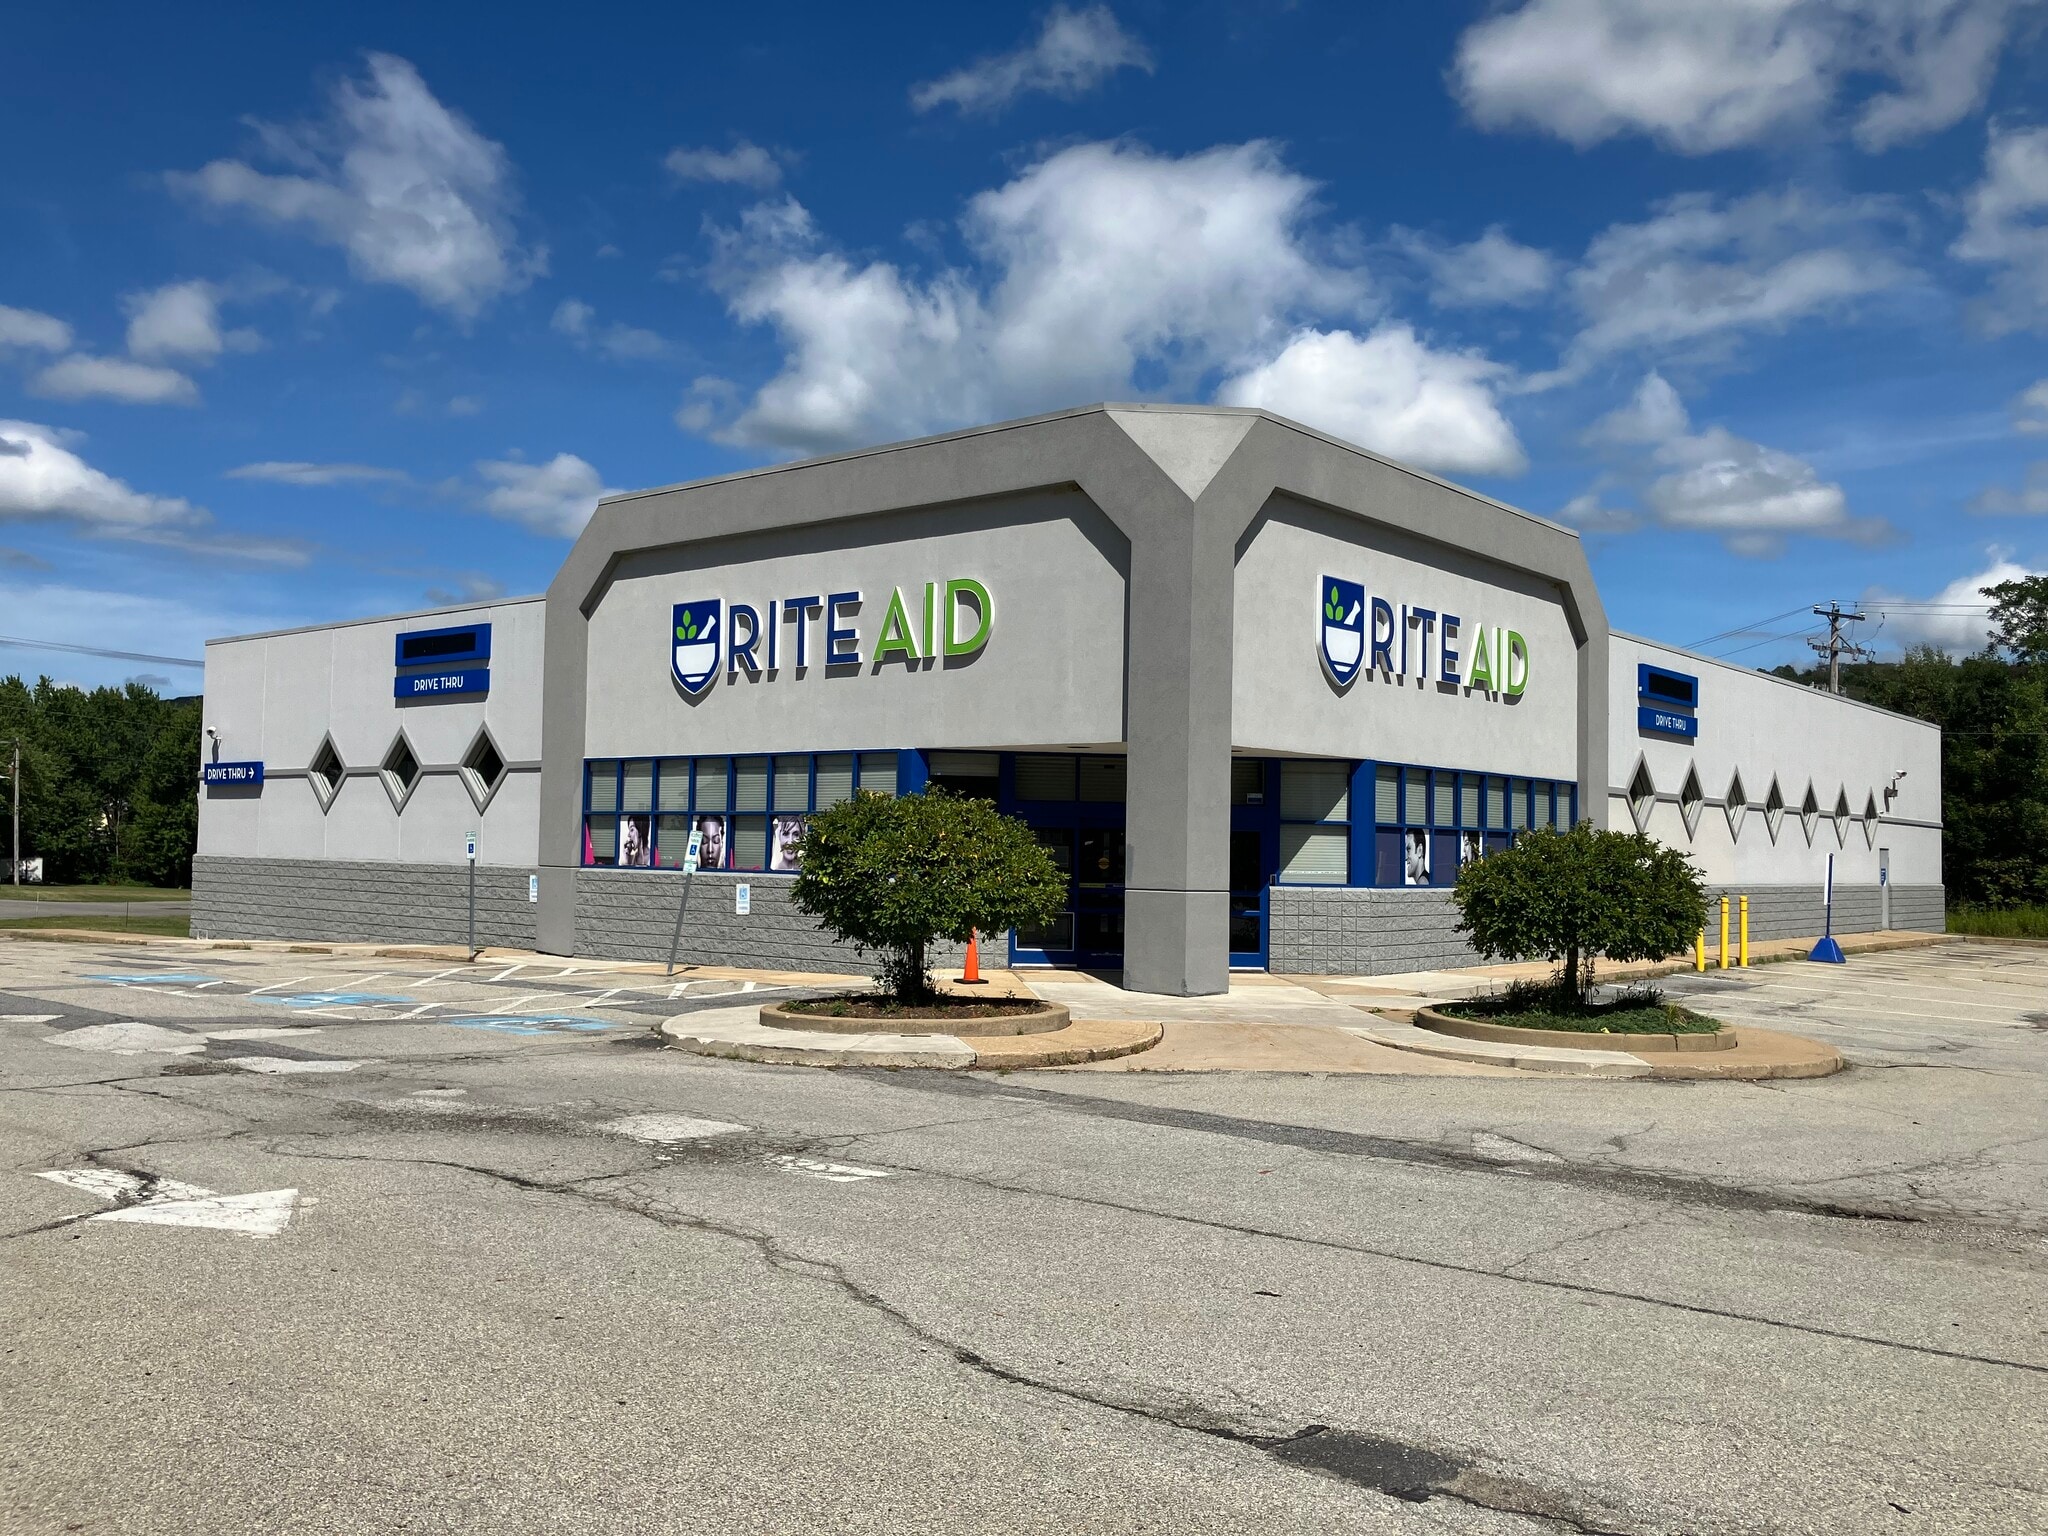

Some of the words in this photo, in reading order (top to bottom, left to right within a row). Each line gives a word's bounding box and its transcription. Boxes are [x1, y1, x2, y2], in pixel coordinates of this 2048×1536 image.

[728, 591, 863, 672] RITE
[872, 578, 996, 662] AID
[1366, 596, 1461, 684] RITE
[1464, 622, 1530, 696] AID
[414, 678, 439, 691] DRIVE
[440, 675, 464, 690] THRU
[1655, 714, 1672, 728] DRIVE
[1672, 717, 1687, 731] THRU
[207, 768, 227, 780] DRIVE
[227, 767, 246, 780] THRU
